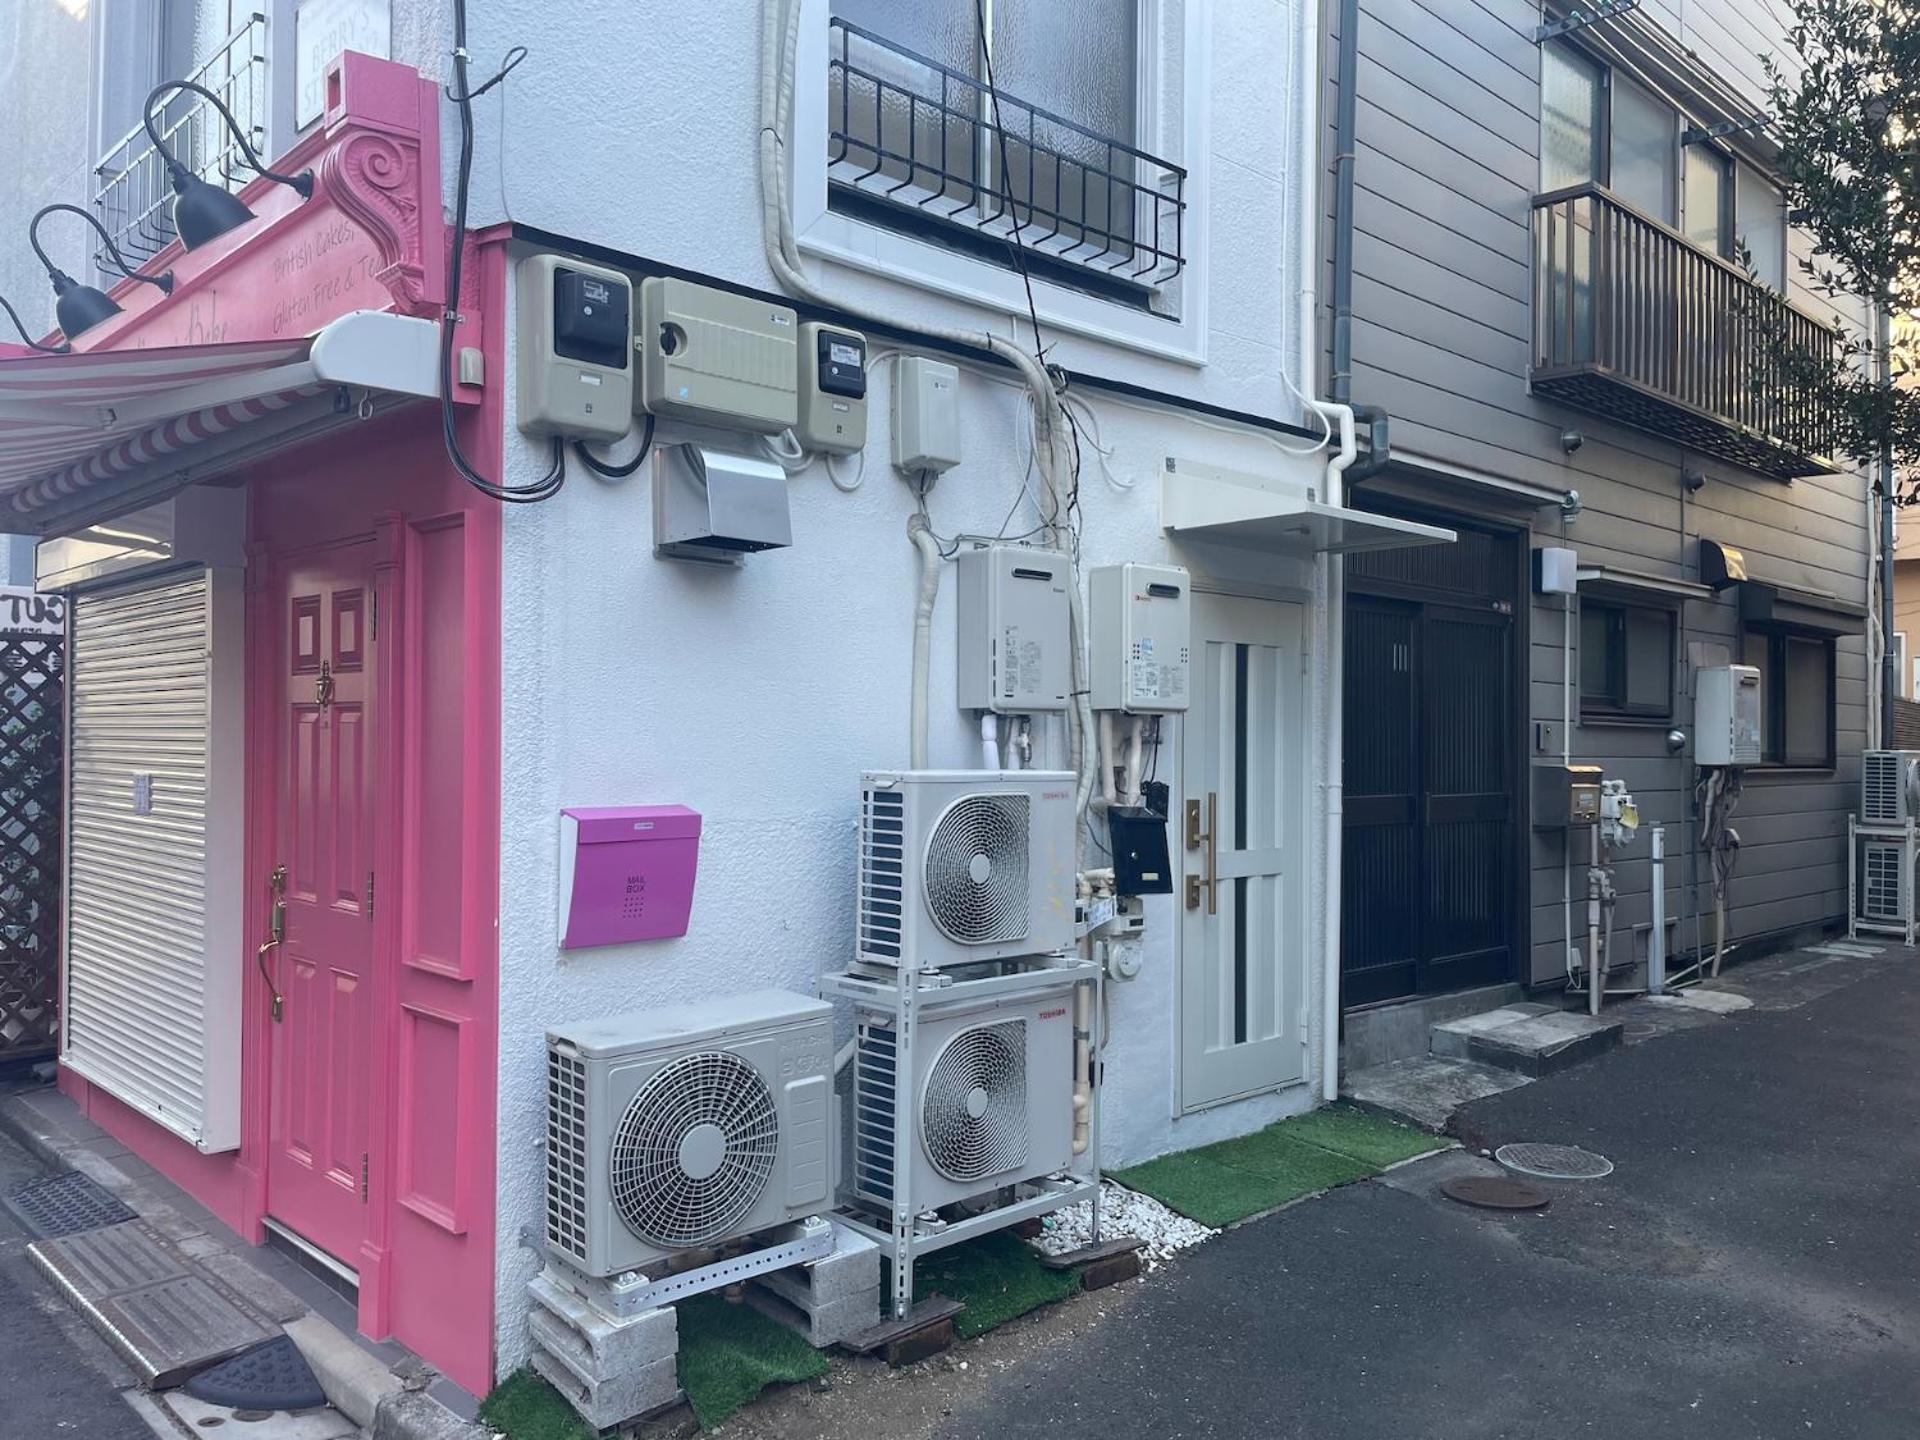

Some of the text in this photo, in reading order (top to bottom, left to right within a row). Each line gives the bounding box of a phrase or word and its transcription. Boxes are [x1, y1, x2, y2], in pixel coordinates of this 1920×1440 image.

[313, 276, 341, 311] Free
[626, 884, 645, 894] BOX
[1039, 1008, 1066, 1020] TOSHIBA
